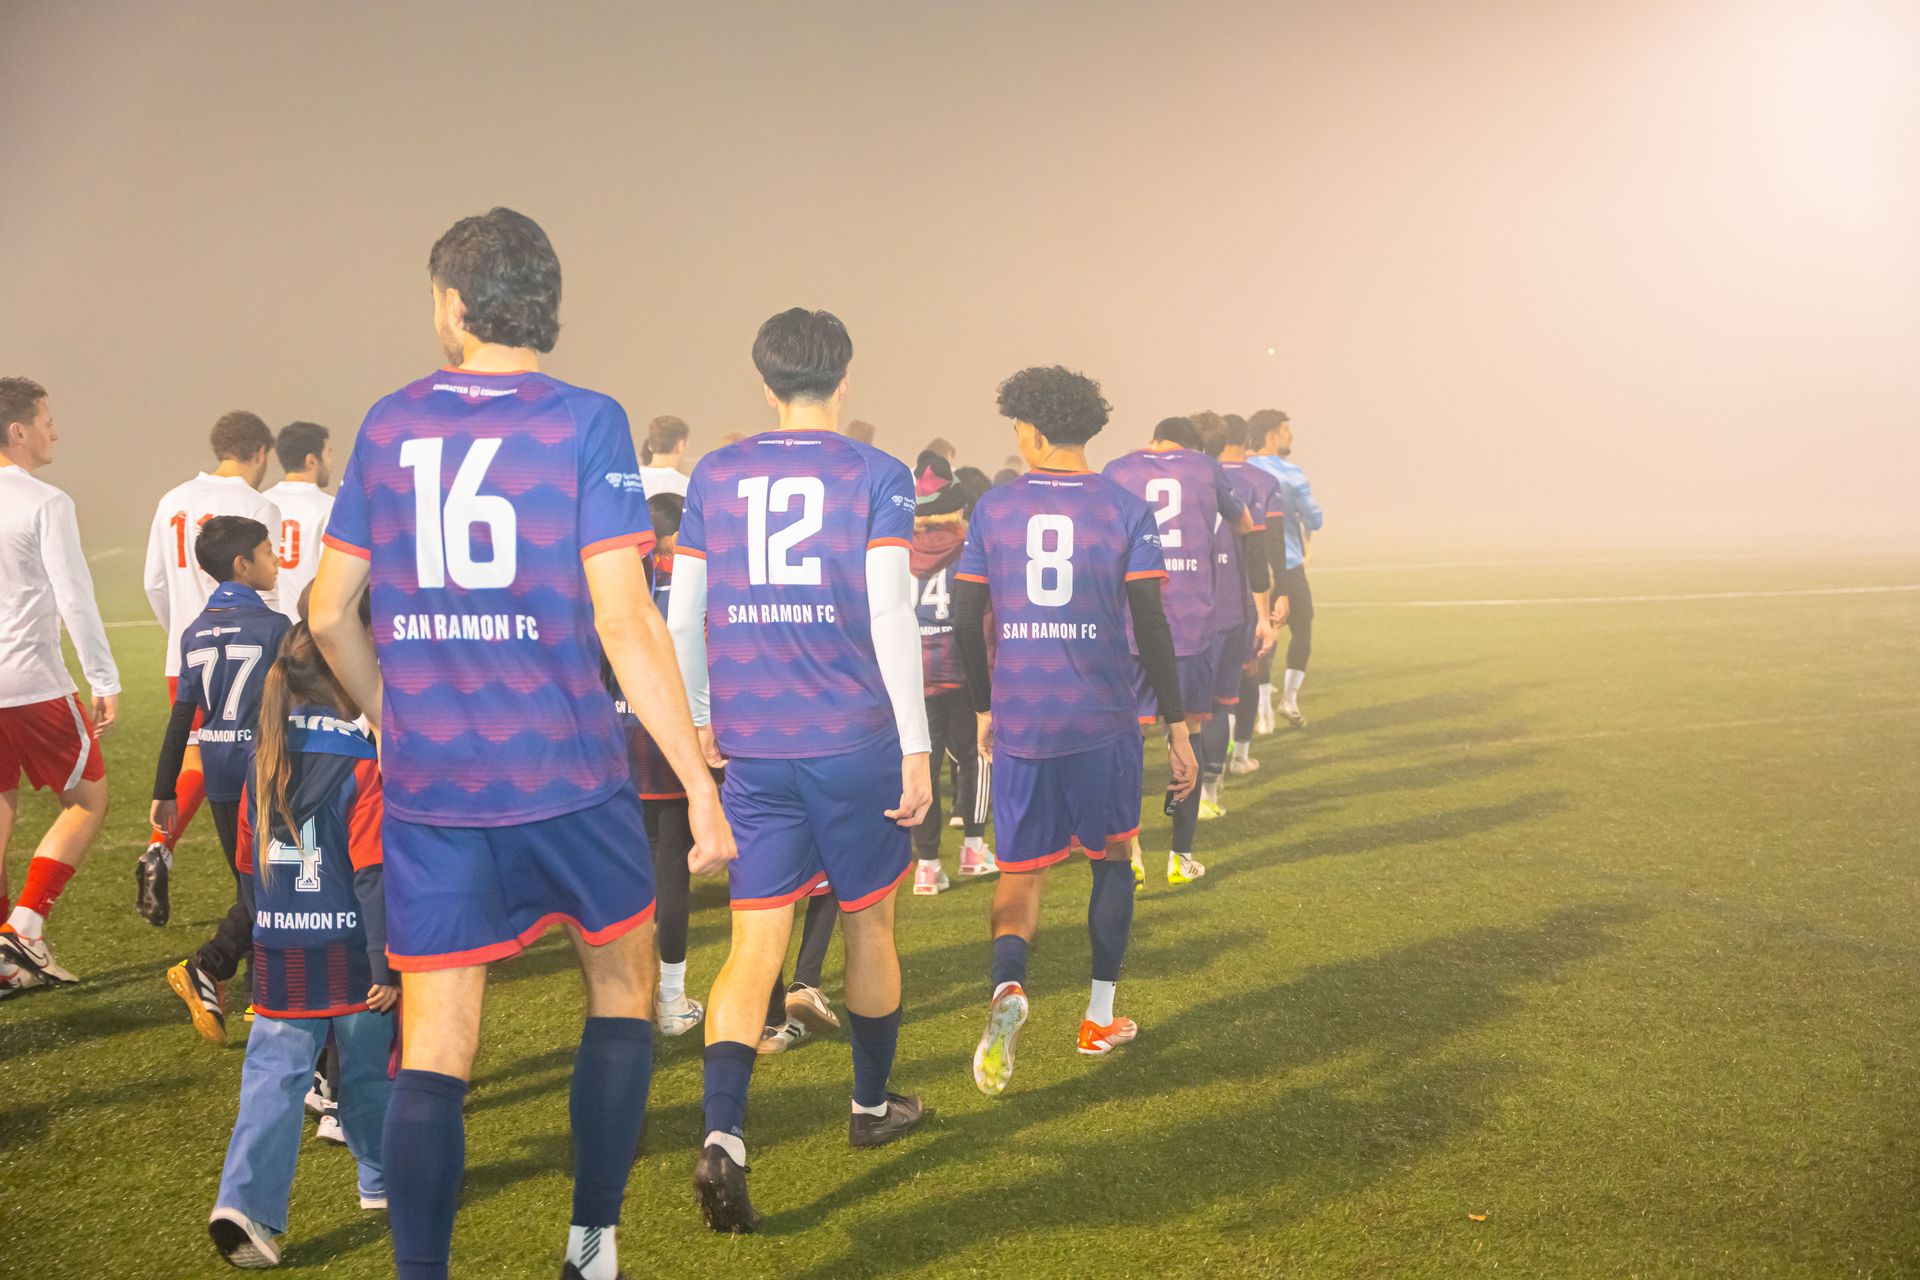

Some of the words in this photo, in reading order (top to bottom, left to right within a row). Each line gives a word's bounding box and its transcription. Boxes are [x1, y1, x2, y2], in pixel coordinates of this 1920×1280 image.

[399, 437, 516, 589] 16
[737, 476, 825, 585] 12
[1145, 478, 1182, 547] 2
[170, 511, 212, 568] 1
[1026, 514, 1074, 606] 8
[1164, 559, 1185, 571] MON
[1186, 559, 1197, 571] FC
[728, 604, 758, 623] SAN
[761, 604, 812, 623] RAMON
[817, 604, 835, 623] FC
[911, 567, 950, 620] 4
[393, 614, 431, 640] SAN
[434, 613, 510, 640] RAMON
[516, 615, 539, 640] FC
[919, 626, 940, 636] MON
[1003, 623, 1028, 639] SAN
[1032, 623, 1077, 639] RAMON
[1081, 623, 1097, 639] FC
[186, 644, 262, 720] 77
[237, 728, 252, 742] FC
[266, 815, 322, 892] 4
[257, 911, 271, 929] AN
[274, 912, 332, 930] RAMON
[336, 911, 357, 929] FC
